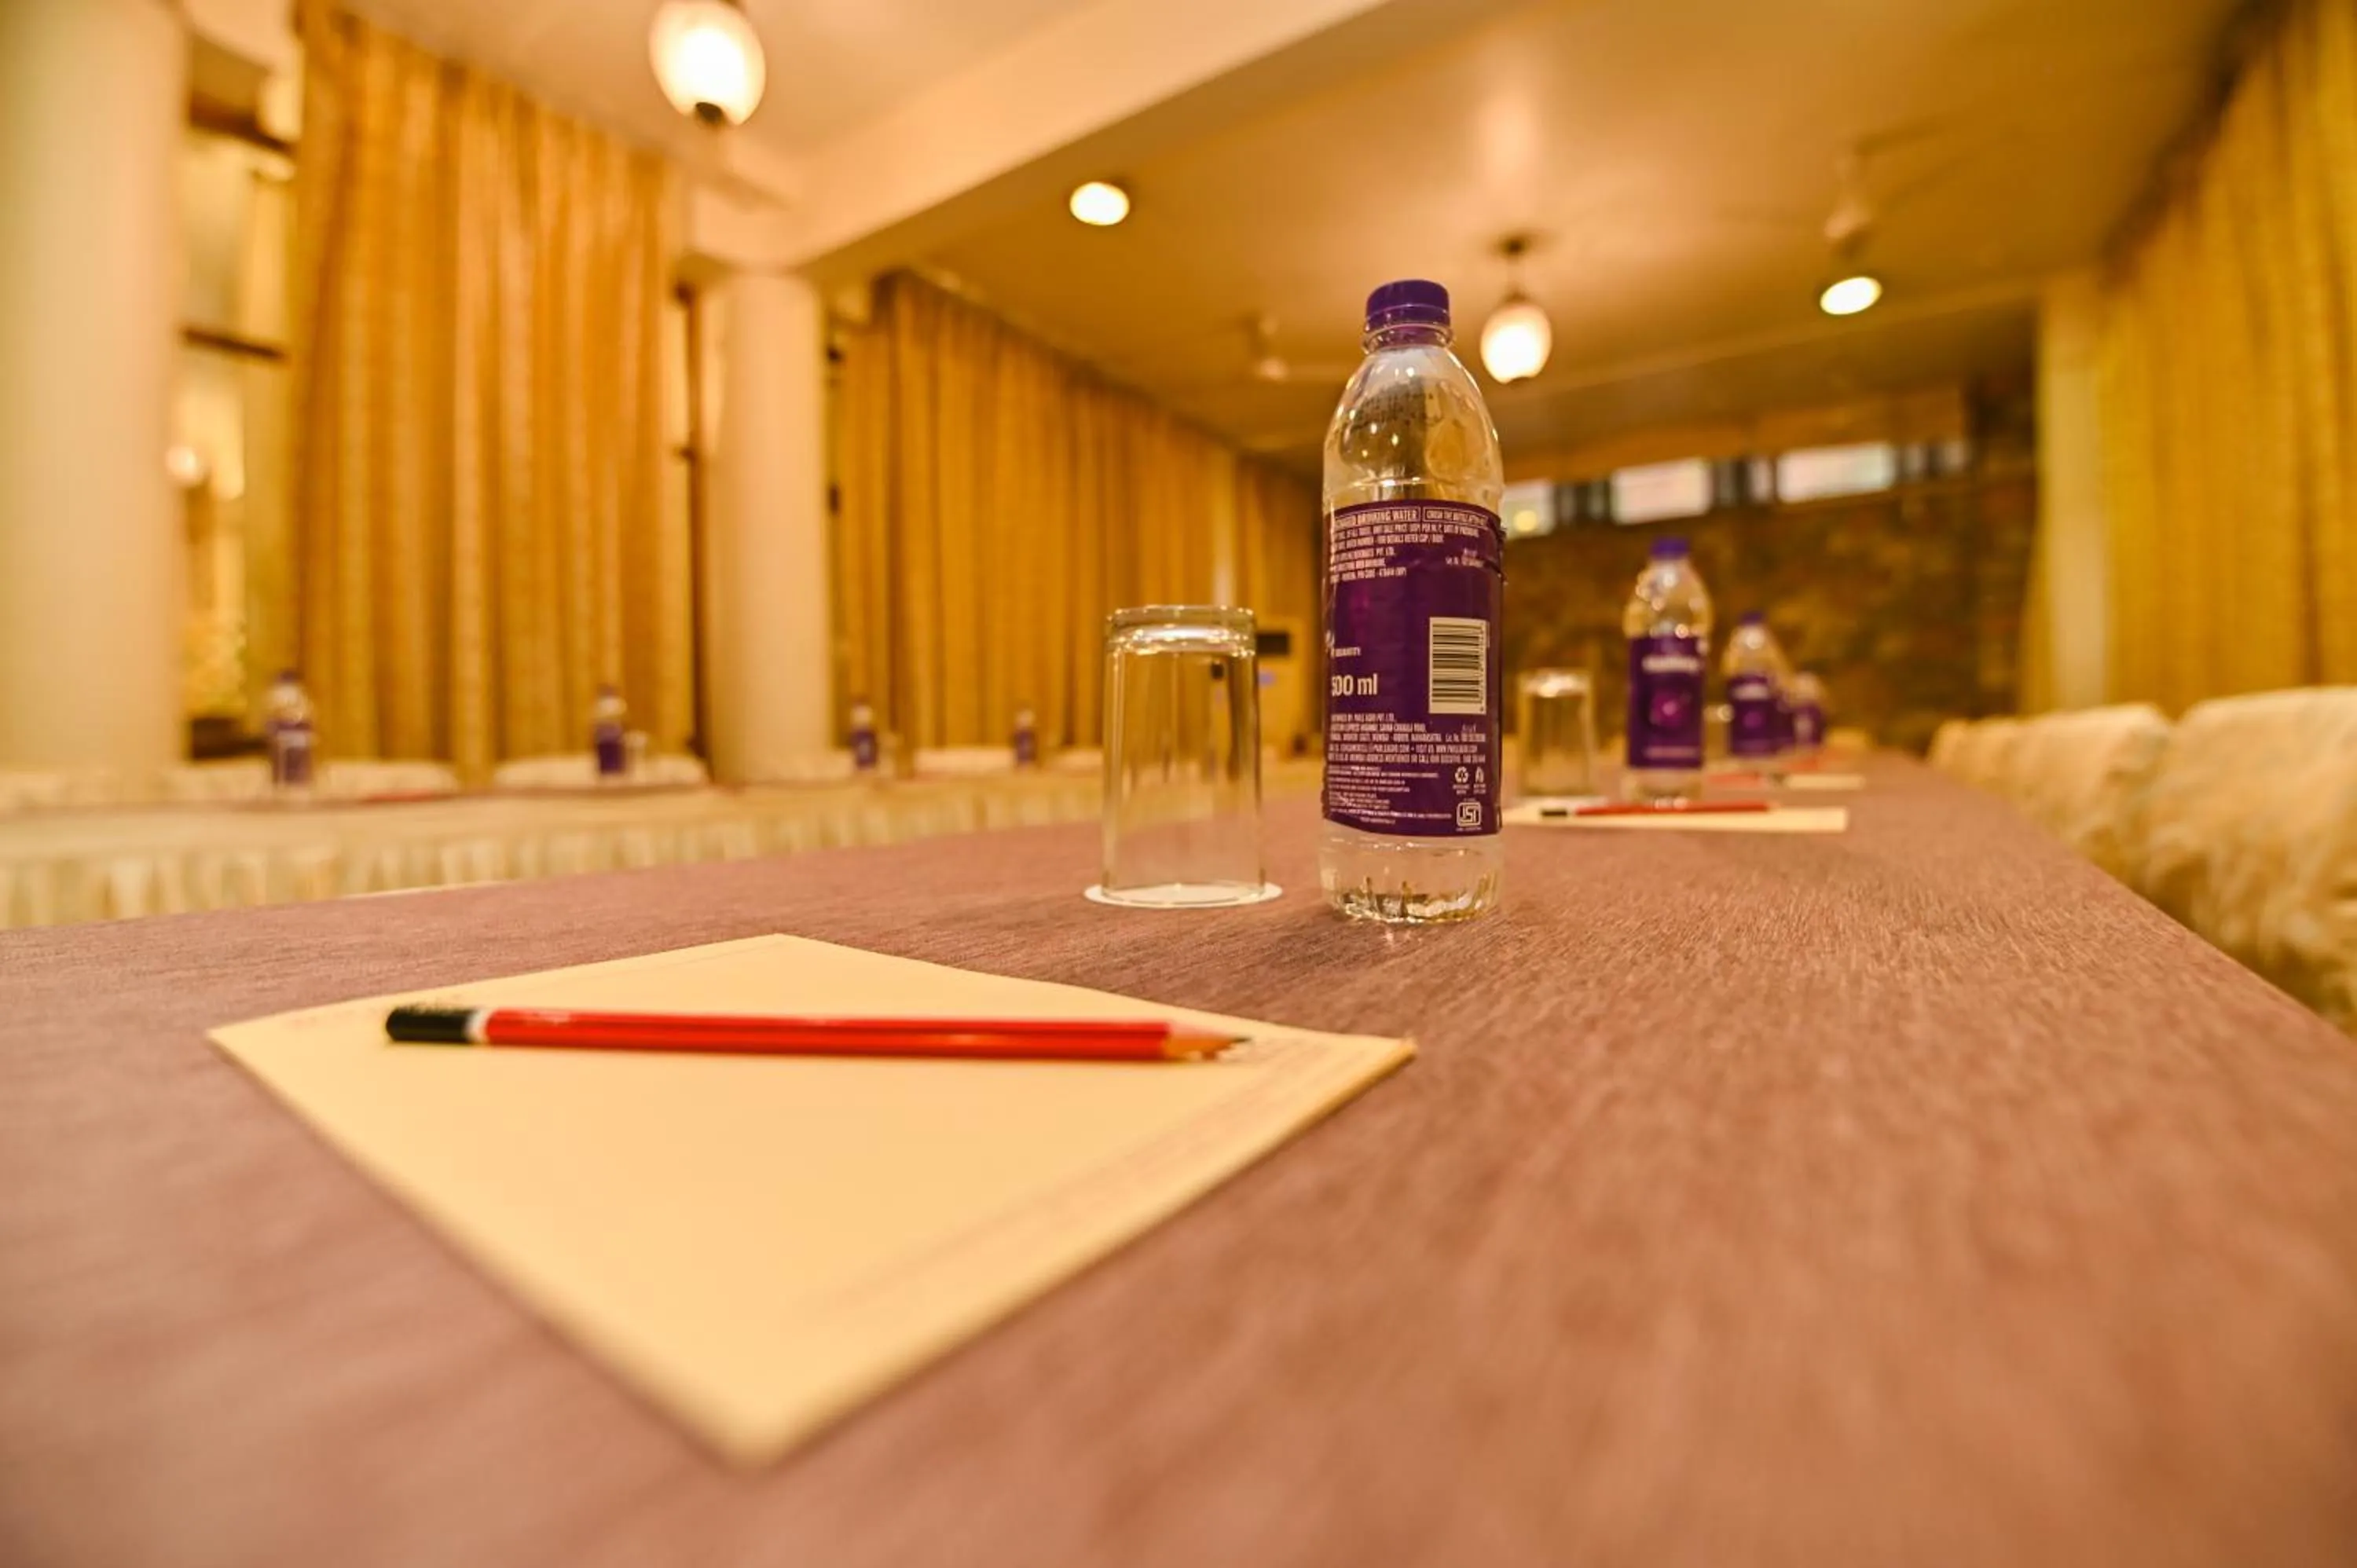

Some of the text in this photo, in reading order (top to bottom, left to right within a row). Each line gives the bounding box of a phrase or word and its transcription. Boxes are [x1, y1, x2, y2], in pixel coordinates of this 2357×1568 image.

[1357, 511, 1391, 525] DRINKING
[1391, 509, 1417, 521] WATER
[1426, 509, 1443, 519] CRUSH
[1357, 673, 1378, 695] ml
